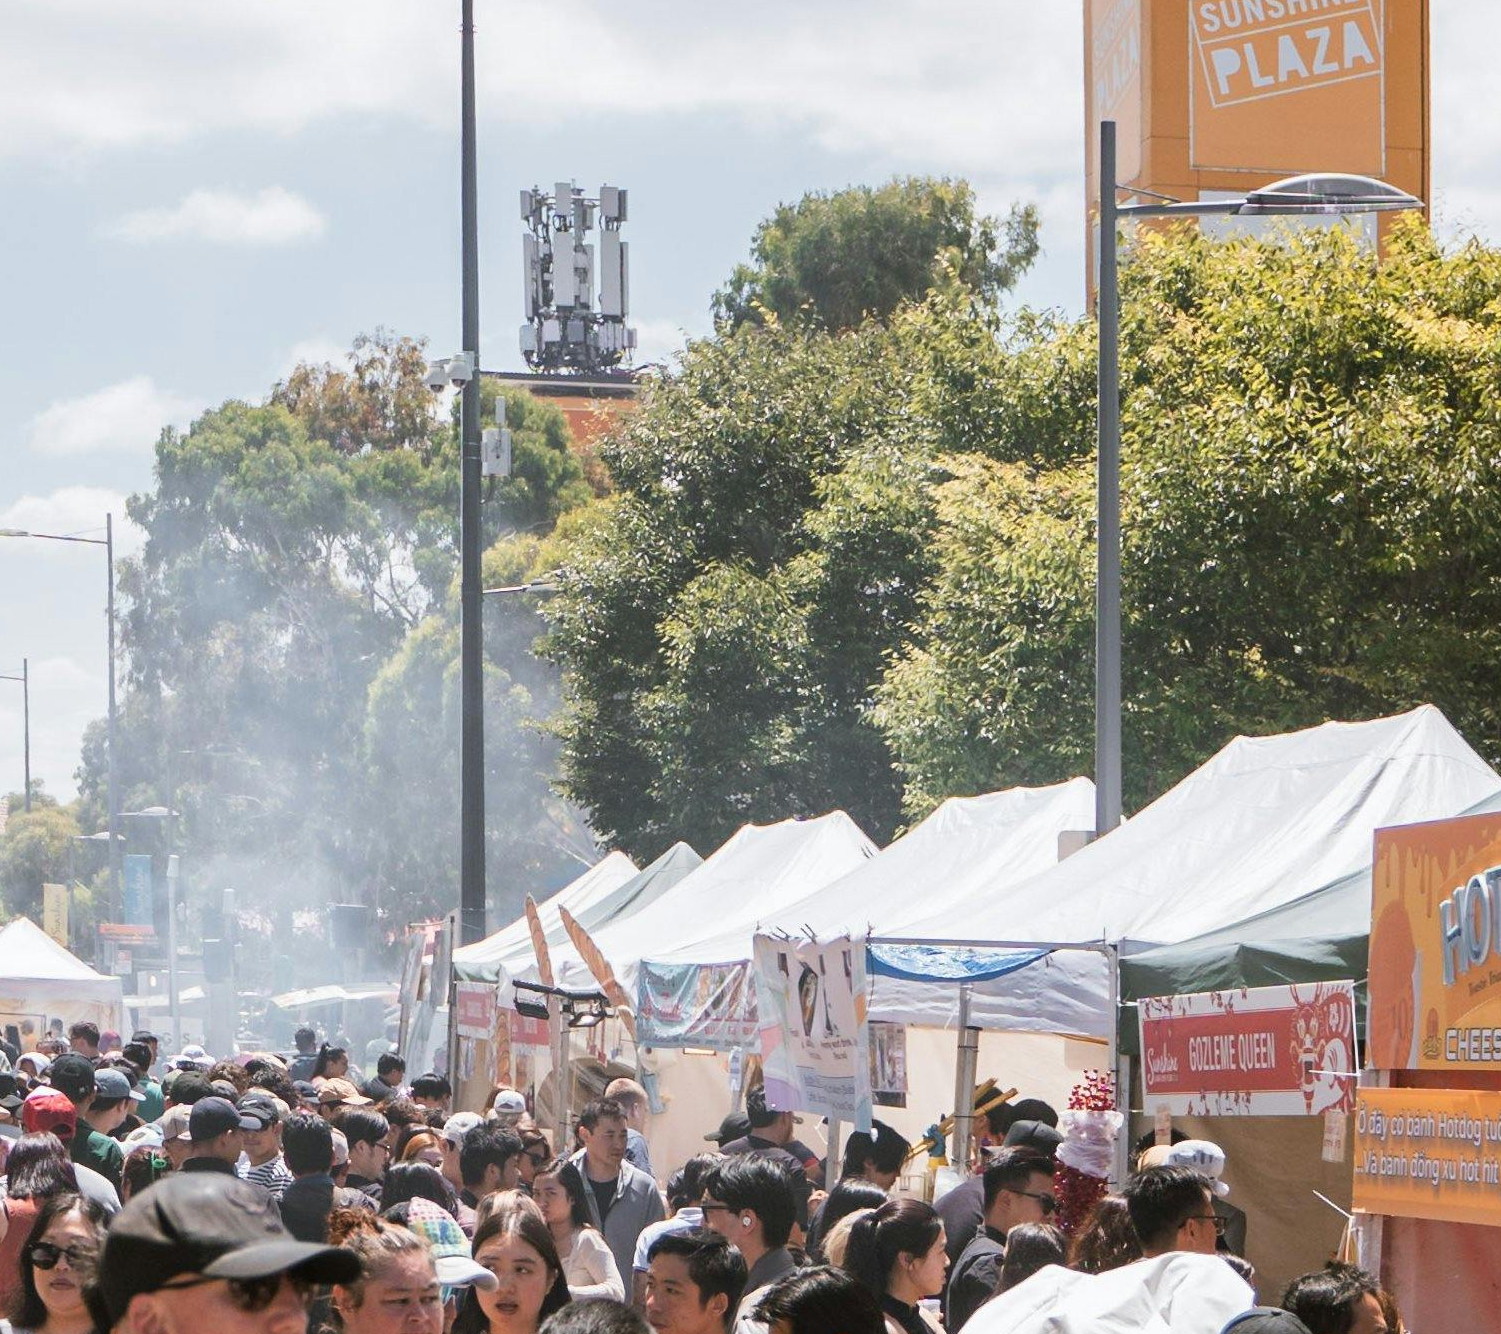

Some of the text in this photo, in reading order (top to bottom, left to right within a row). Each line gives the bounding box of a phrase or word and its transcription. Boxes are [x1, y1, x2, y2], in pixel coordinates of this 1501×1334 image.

[1210, 21, 1375, 95] PLAZA
[1188, 1032, 1276, 1072] GOZLEME QUEEN
[1368, 1108, 1388, 1140] đây
[1406, 1107, 1435, 1138] bánh
[1438, 1111, 1482, 1147] Hotdog
[1441, 1160, 1457, 1180] xu
[1459, 1154, 1479, 1183] hot
[1482, 1156, 1499, 1184] hit
